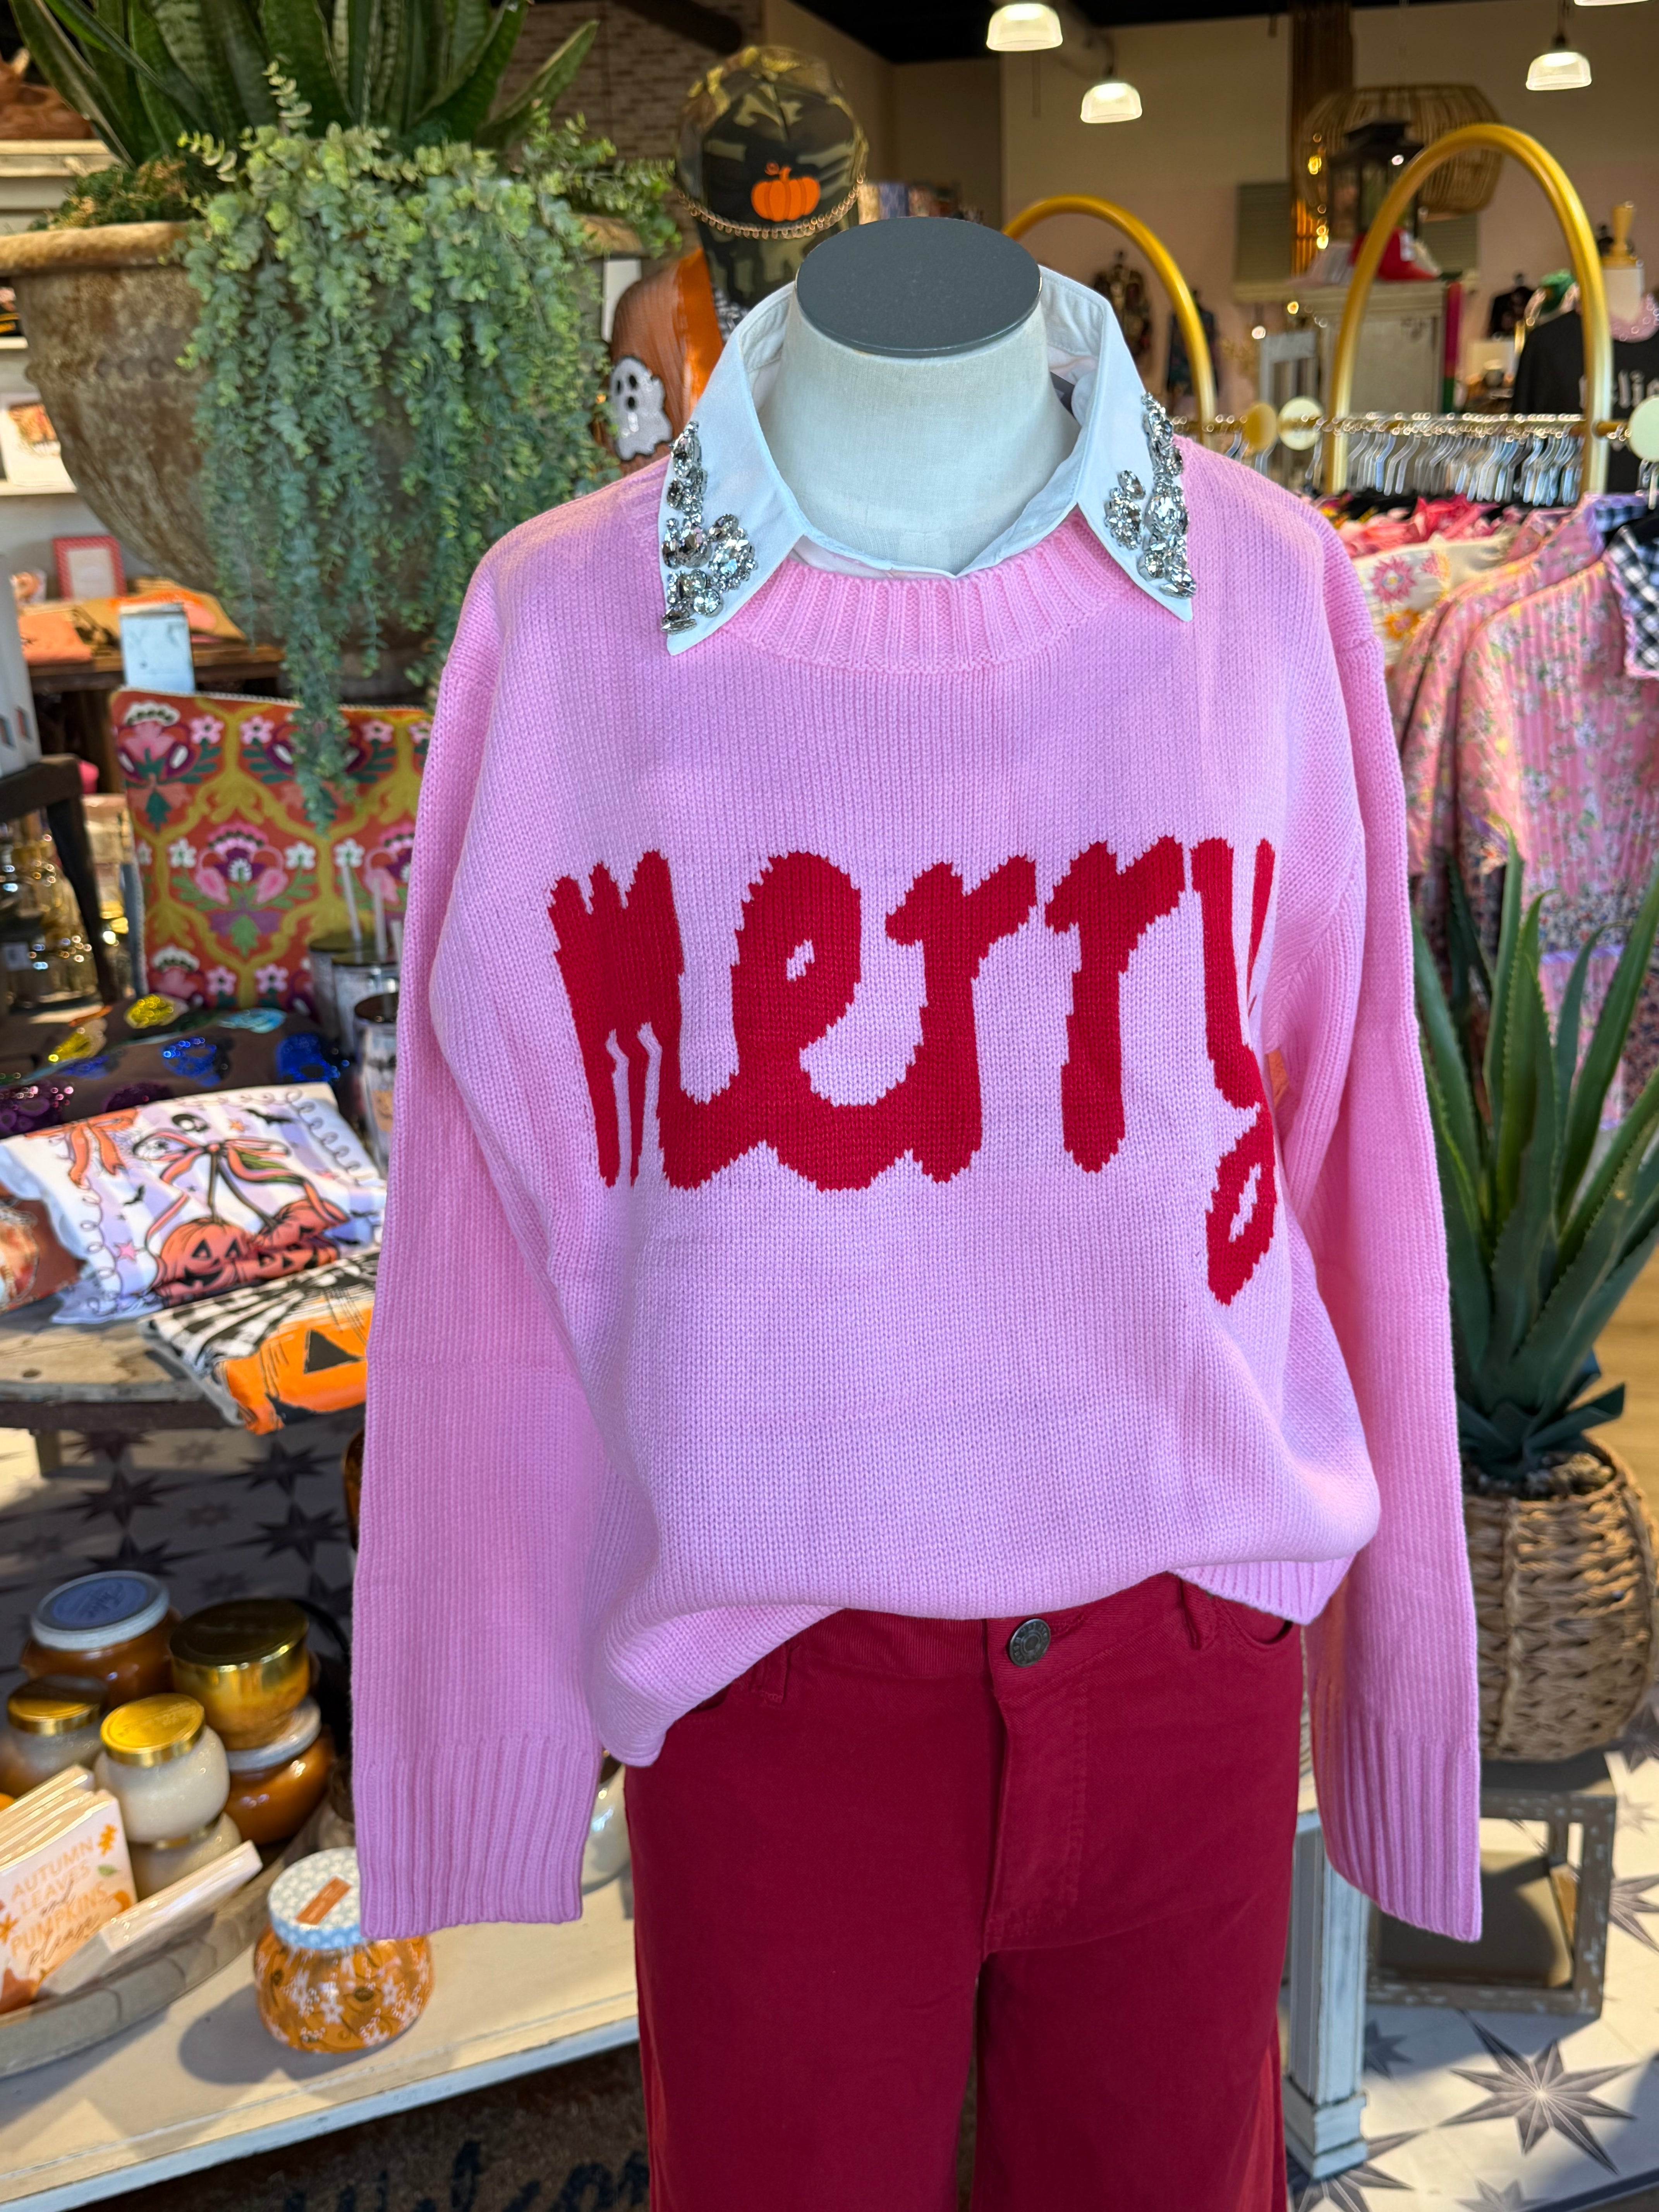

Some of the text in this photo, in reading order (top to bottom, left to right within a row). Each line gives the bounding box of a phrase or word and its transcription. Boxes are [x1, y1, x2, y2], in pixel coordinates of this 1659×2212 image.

[11, 1836, 94, 1901] AUTUMN
[21, 1862, 91, 1915] LEAVES
[10, 1881, 108, 1958] PUMPKINS
